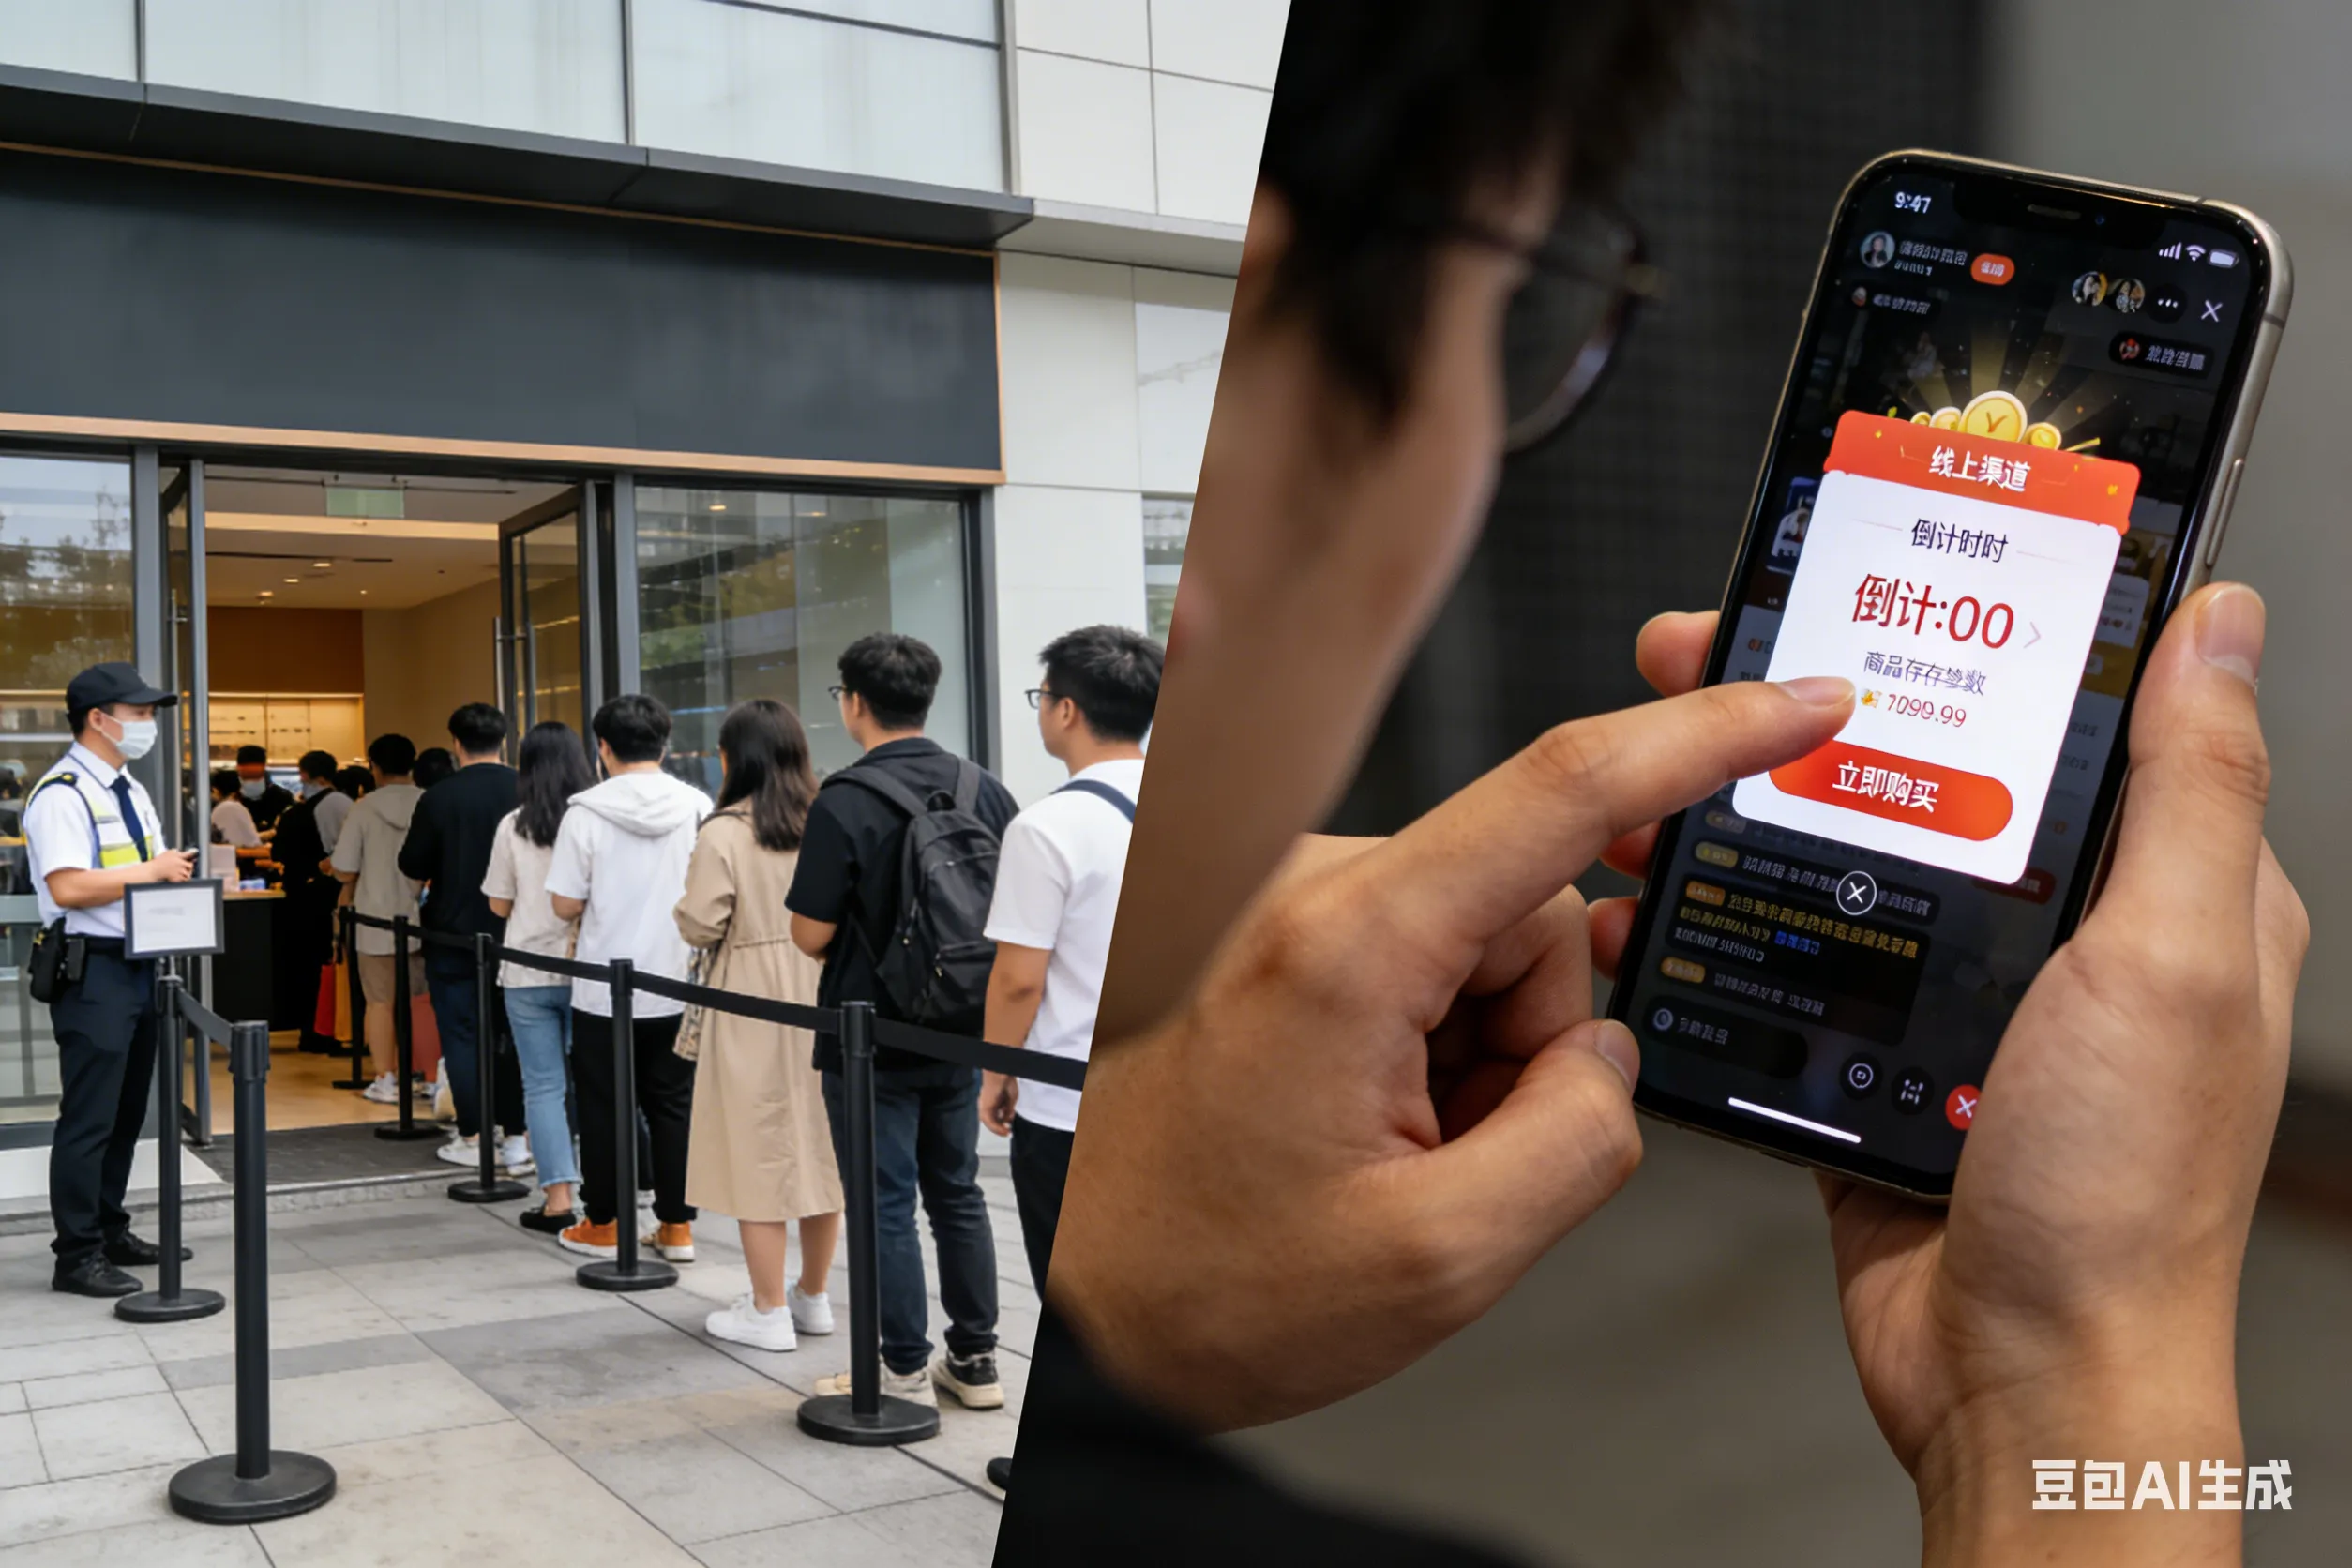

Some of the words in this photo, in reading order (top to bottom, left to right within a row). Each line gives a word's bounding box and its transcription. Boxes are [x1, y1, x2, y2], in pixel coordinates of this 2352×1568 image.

[1894, 191, 1931, 214] 9:47
[1929, 445, 2031, 492] 线上渠道
[1911, 518, 2009, 563] 倒计时时
[1851, 573, 2014, 649] 倒计:00
[1832, 761, 1940, 813] 立即购买
